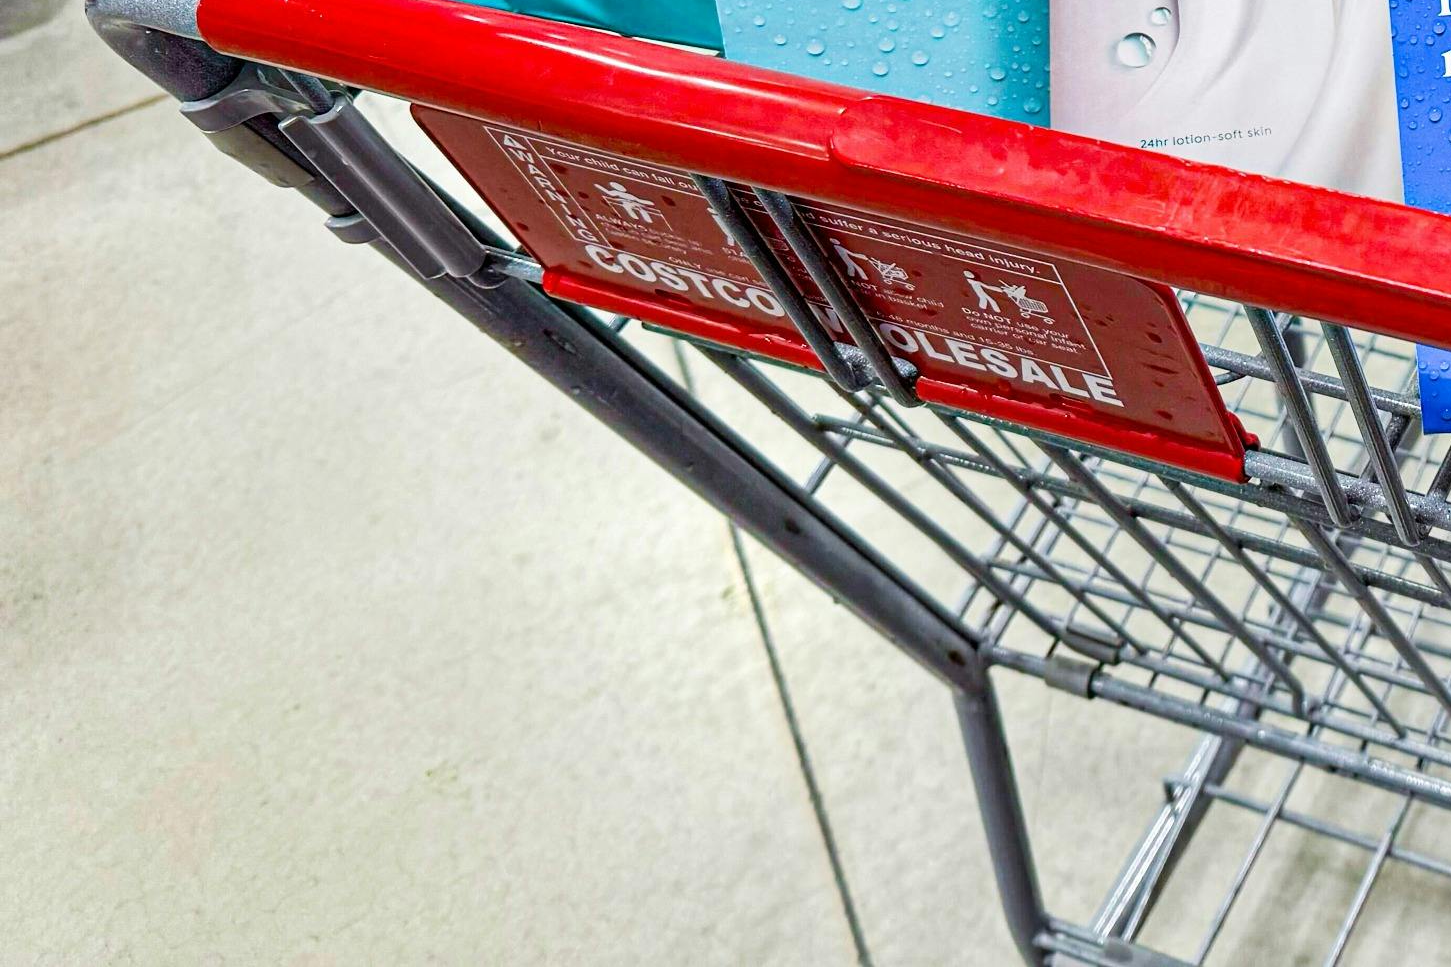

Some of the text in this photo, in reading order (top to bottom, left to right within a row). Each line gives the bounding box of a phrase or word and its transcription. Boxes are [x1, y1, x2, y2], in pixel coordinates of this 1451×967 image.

[1141, 125, 1272, 149] 24hr lotion-soft skin
[545, 147, 700, 192] Your child can fall ou
[507, 148, 599, 243] WARNING
[820, 216, 863, 232] suffer
[882, 231, 941, 250] serious
[945, 244, 985, 261] head
[990, 255, 1041, 274] injury.
[585, 245, 786, 317] COSTCO
[984, 314, 1011, 326] NOT
